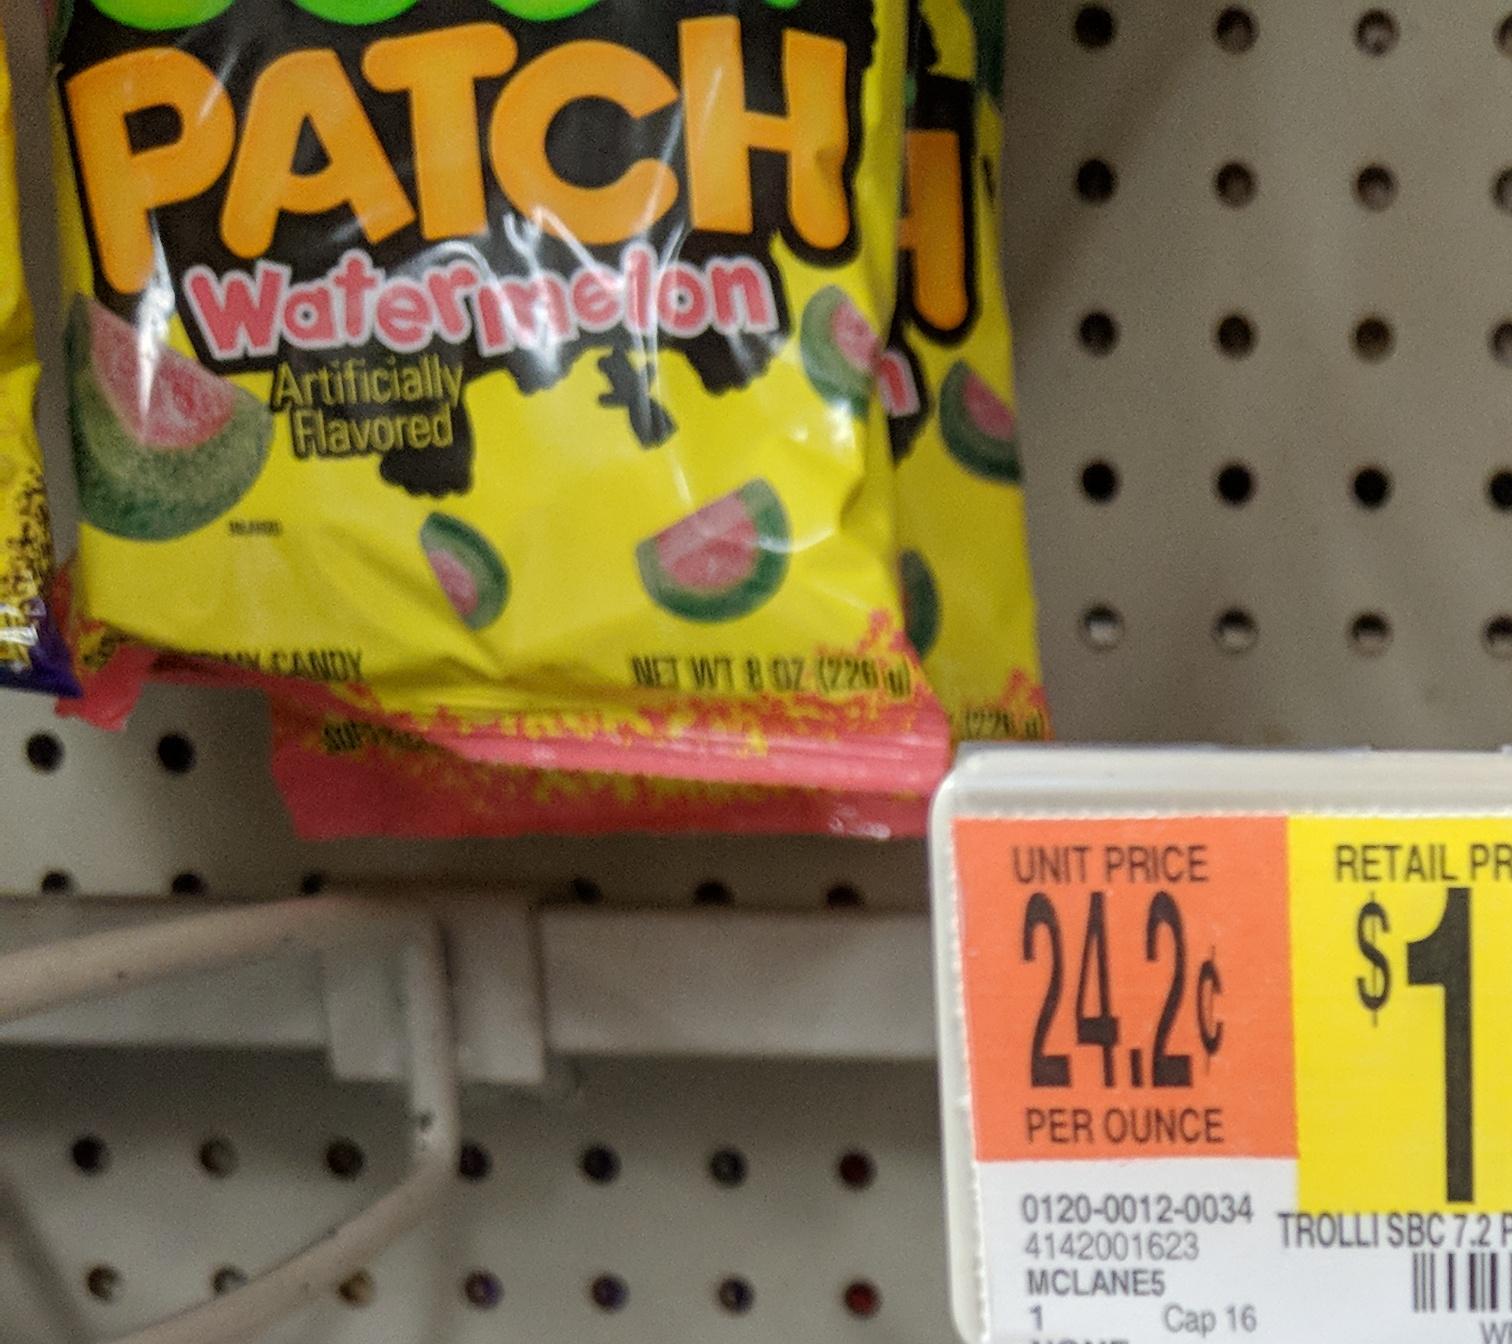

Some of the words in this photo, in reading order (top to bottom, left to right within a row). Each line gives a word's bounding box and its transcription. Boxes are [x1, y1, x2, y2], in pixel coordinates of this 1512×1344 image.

[66, 15, 850, 294] PATCH
[183, 243, 781, 358] Watermelon
[273, 353, 464, 408] Artificially
[295, 406, 454, 454] Flavored
[271, 646, 364, 683] CANDY
[631, 655, 680, 688] NET
[691, 654, 736, 689] WT
[745, 654, 766, 692] 8
[770, 655, 804, 693] OZ
[1011, 846, 1098, 883] UNIT
[1105, 845, 1209, 882] PRICE
[1334, 845, 1460, 882] RETAIL
[1025, 1109, 1098, 1145] PER
[1104, 1108, 1225, 1145] OUNCE
[1022, 1194, 1254, 1225] 0120-0012-0034
[1024, 1231, 1200, 1262] 4142001623
[1278, 1212, 1380, 1249] TROLLI
[1388, 1212, 1445, 1248] SBC
[1453, 1213, 1492, 1248] 7.2
[1029, 1305, 1044, 1331] 1
[1163, 1304, 1217, 1338] Cap
[1226, 1304, 1258, 1332] 16
